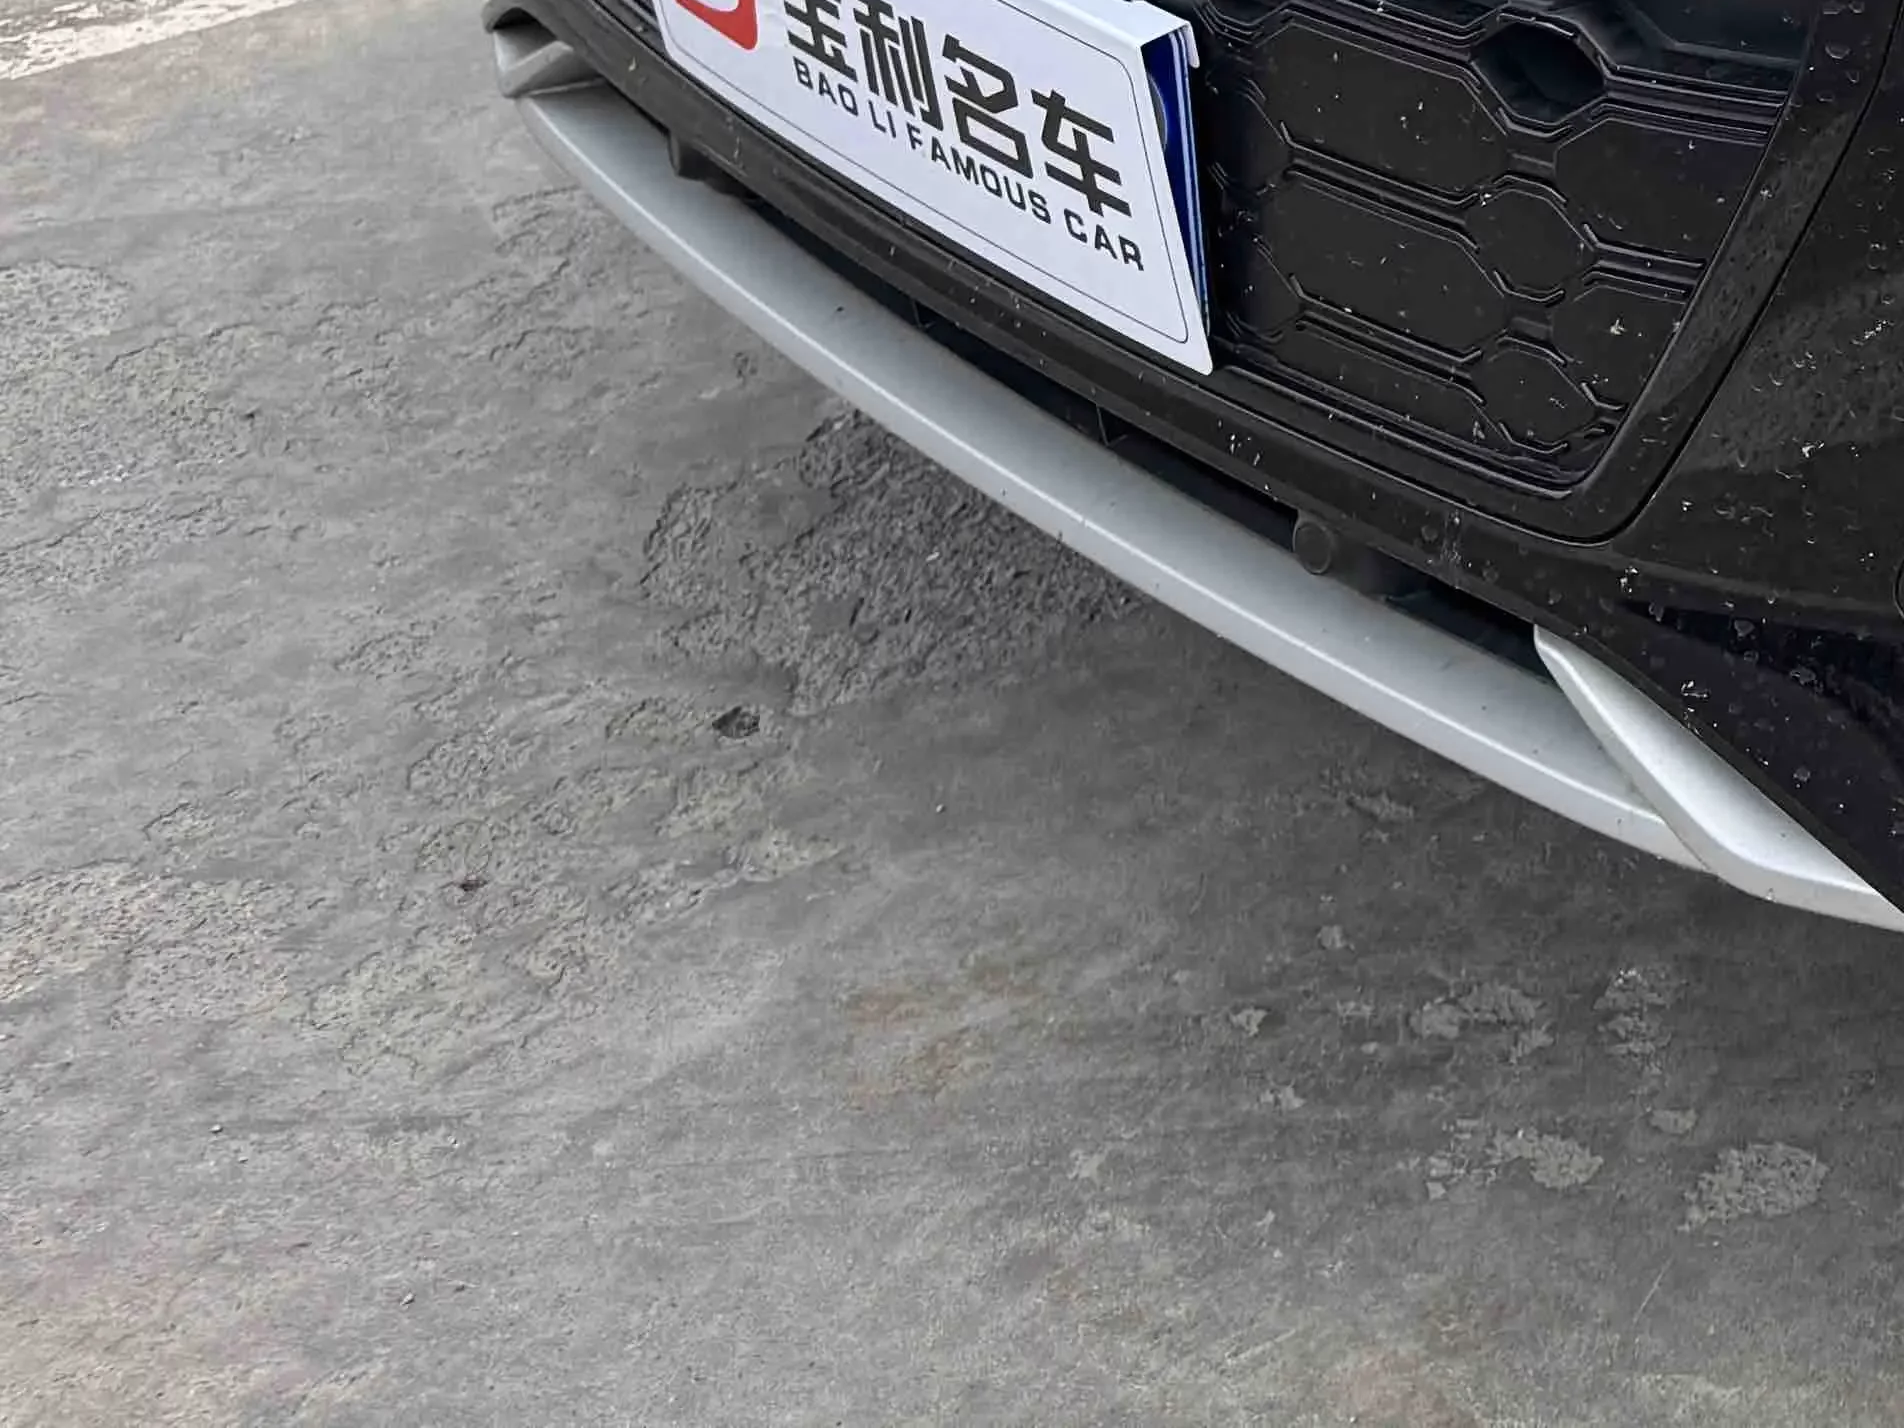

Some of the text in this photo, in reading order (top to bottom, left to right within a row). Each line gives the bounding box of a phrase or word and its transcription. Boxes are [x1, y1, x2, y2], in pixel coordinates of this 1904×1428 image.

[794, 58, 1145, 272] BAO LI FAMOUS CAR
